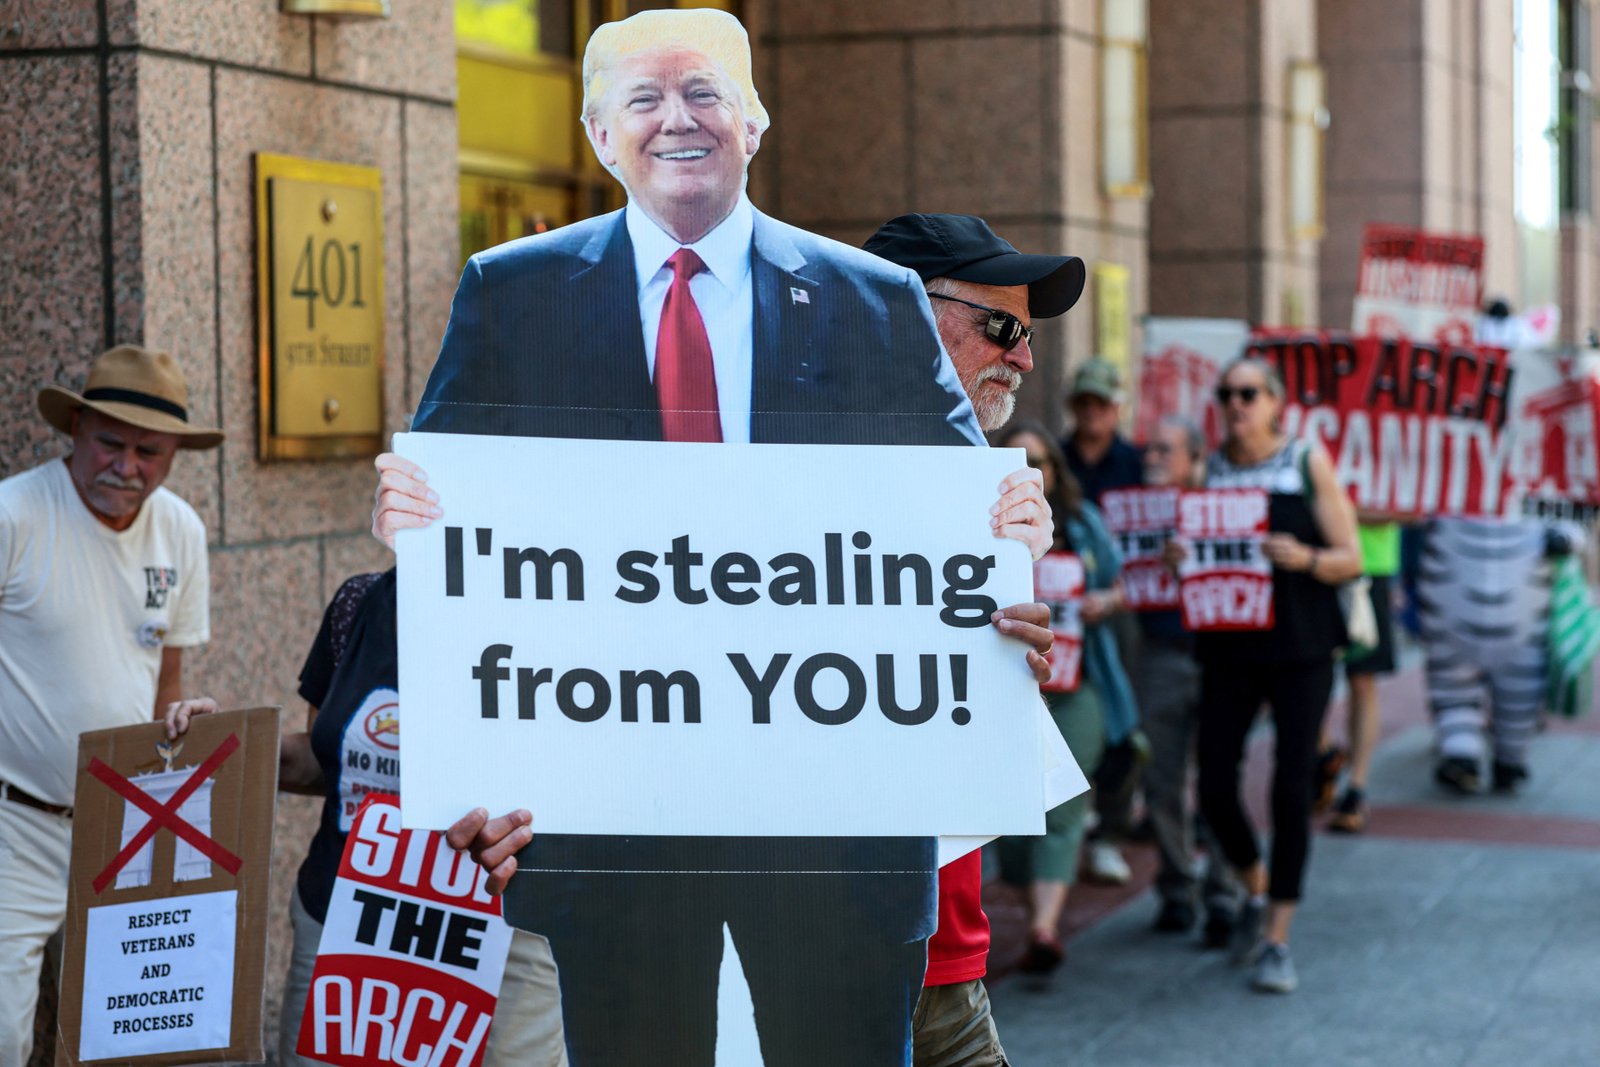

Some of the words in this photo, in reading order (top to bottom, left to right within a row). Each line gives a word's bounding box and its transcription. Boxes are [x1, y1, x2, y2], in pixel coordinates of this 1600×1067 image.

[290, 236, 365, 330] 401
[1366, 340, 1515, 427] ARCH
[1181, 491, 1268, 535] STOP
[1194, 538, 1254, 564] THE
[445, 527, 584, 601] I'm
[614, 531, 998, 628] stealing
[1183, 574, 1272, 630] ARCH
[472, 644, 701, 724] from
[727, 651, 972, 726] YOU!
[347, 749, 371, 771] NO
[127, 908, 192, 930] RESPECT
[353, 888, 489, 971] THE
[120, 932, 196, 956] VETERANS
[140, 963, 171, 980] AND
[106, 986, 205, 1011] DEMOCRATIC
[112, 1012, 194, 1035] PROCESSES
[313, 975, 492, 1067] ARCH
